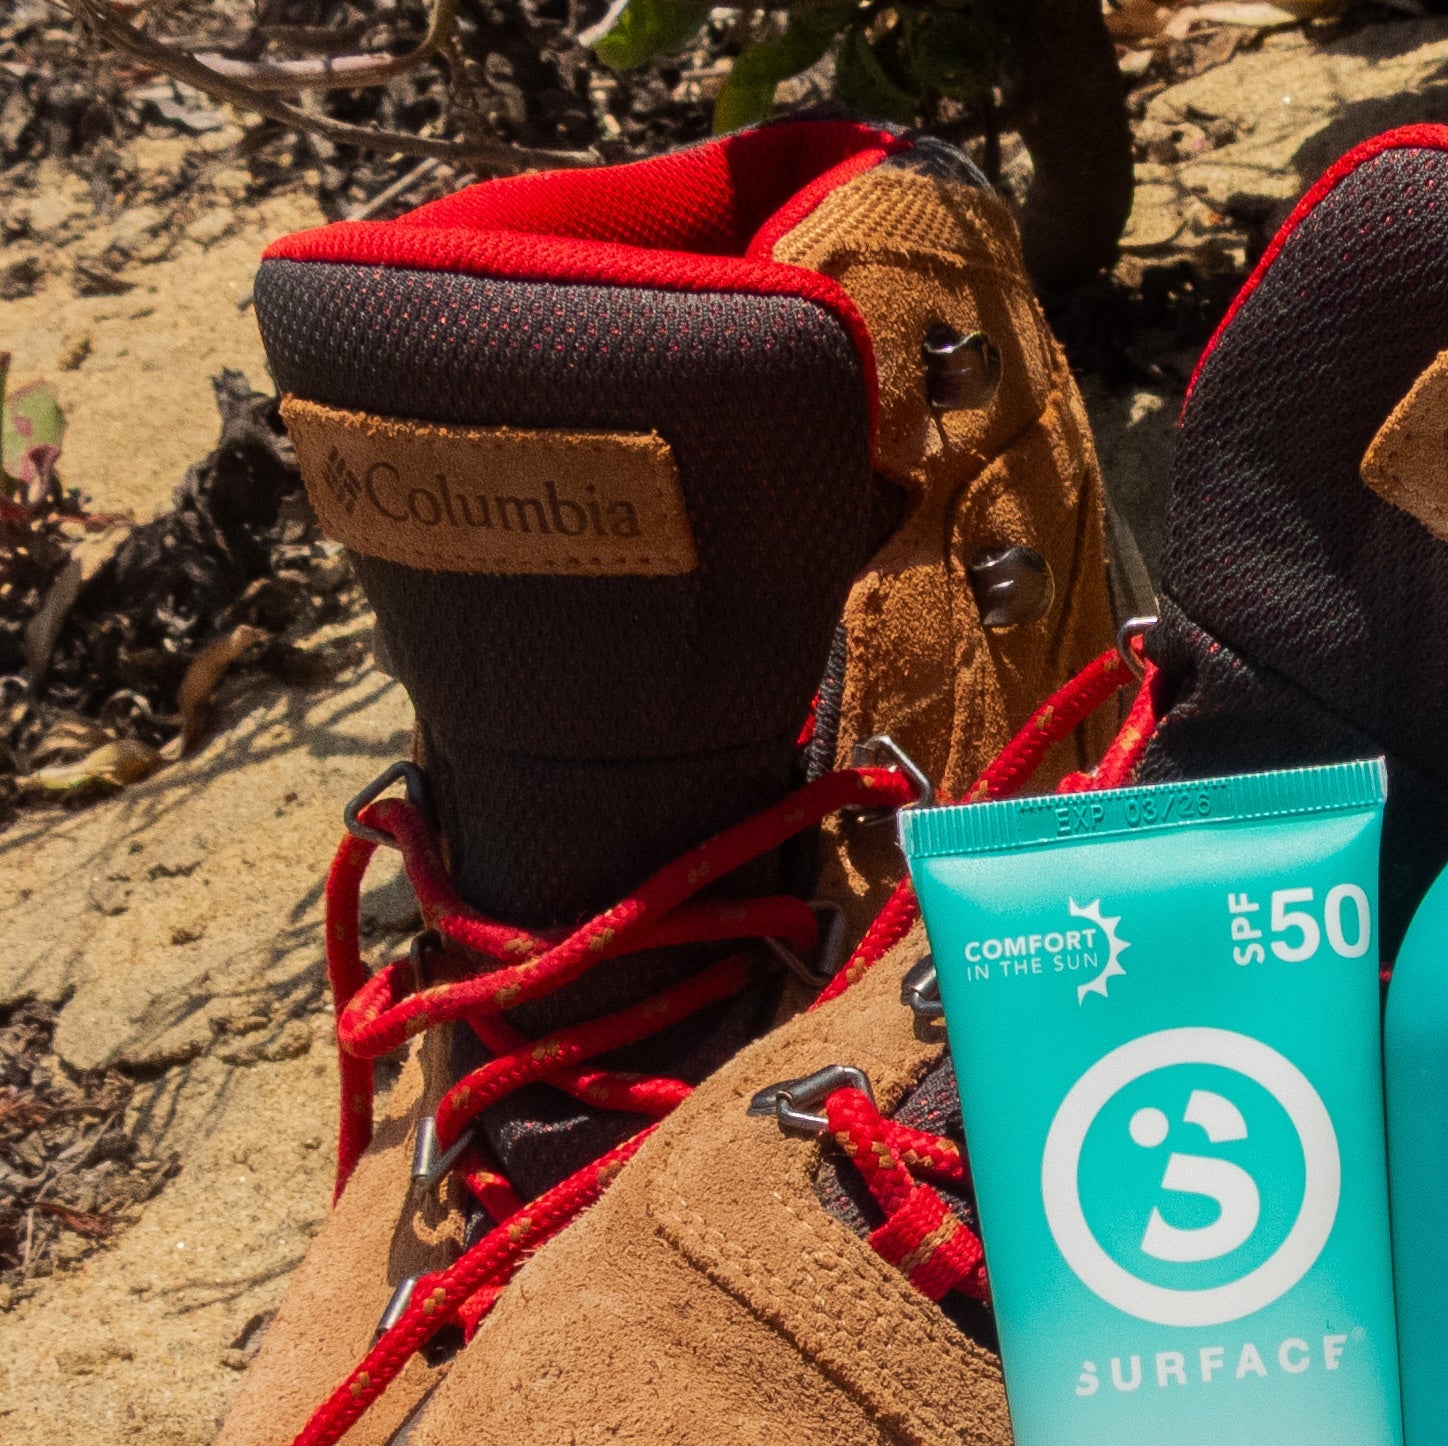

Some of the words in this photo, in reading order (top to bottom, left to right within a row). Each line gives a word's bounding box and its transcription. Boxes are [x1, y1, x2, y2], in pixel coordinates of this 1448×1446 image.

[363, 461, 641, 539] Columbia
[1055, 803, 1104, 834] EXP
[1125, 791, 1212, 826] 03/26
[964, 927, 1096, 963] COMFORT
[1228, 892, 1265, 966] SPF
[1269, 883, 1371, 963] 50
[966, 964, 990, 981] IN
[1000, 957, 1042, 977] THE
[1053, 950, 1098, 972] SUN
[1074, 1334, 1348, 1397] SURFACE
